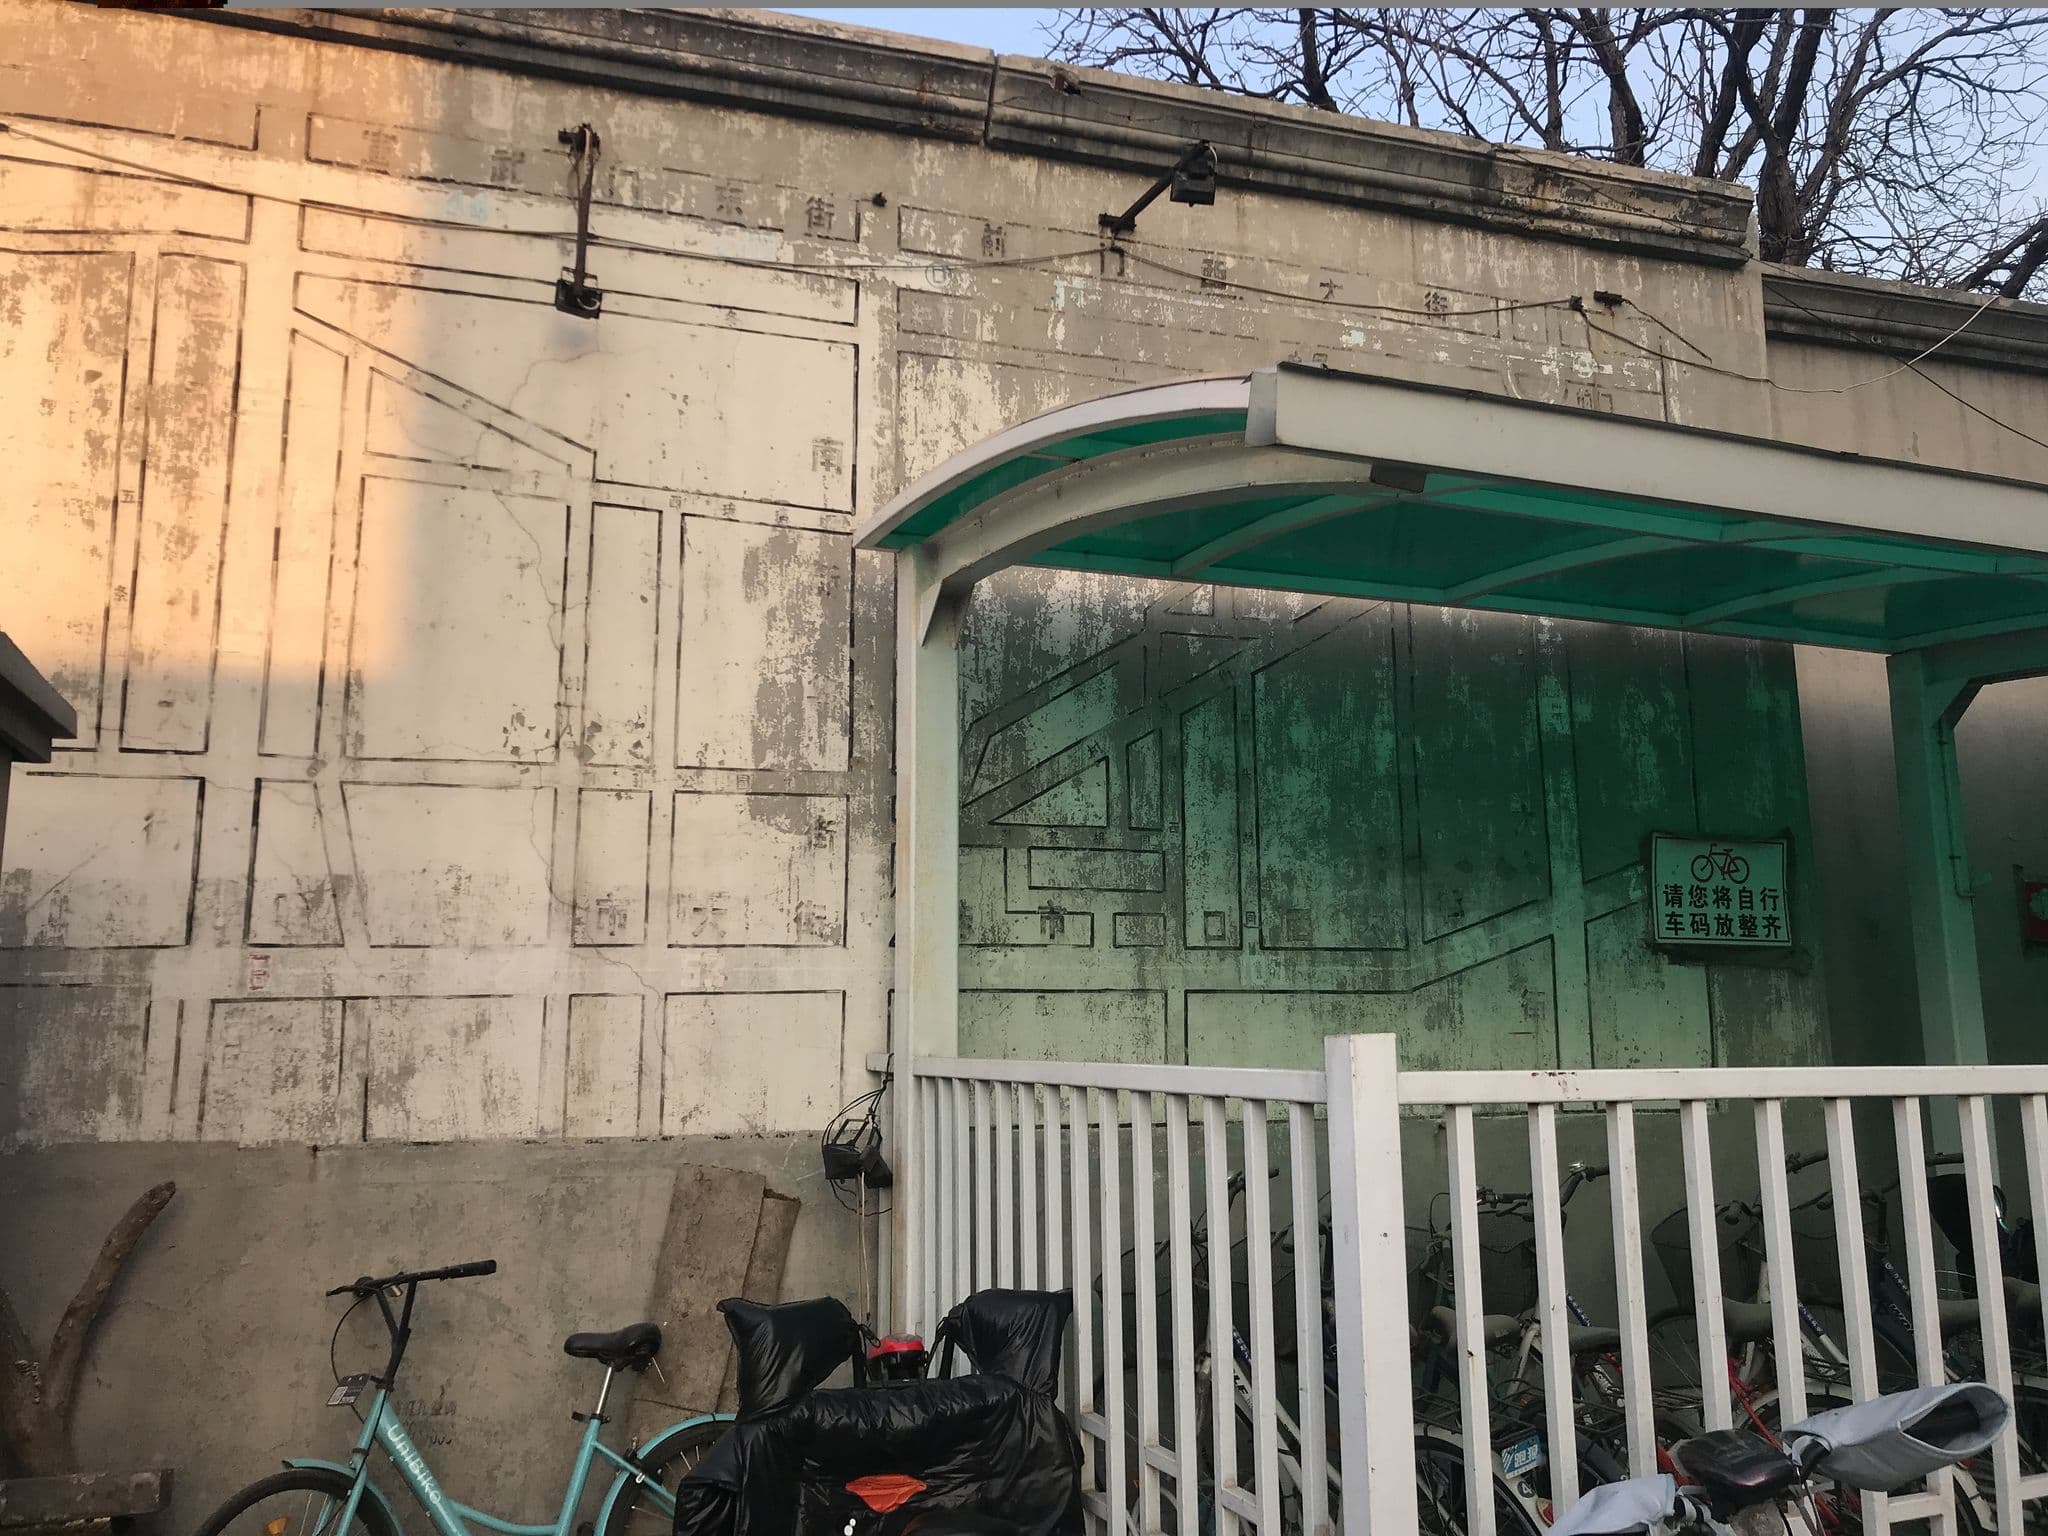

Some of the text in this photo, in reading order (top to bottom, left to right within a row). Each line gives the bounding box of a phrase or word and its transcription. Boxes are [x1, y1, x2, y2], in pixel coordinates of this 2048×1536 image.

[1663, 884, 1780, 911] 请您将自行
[1665, 912, 1782, 938] 车码放整齐
